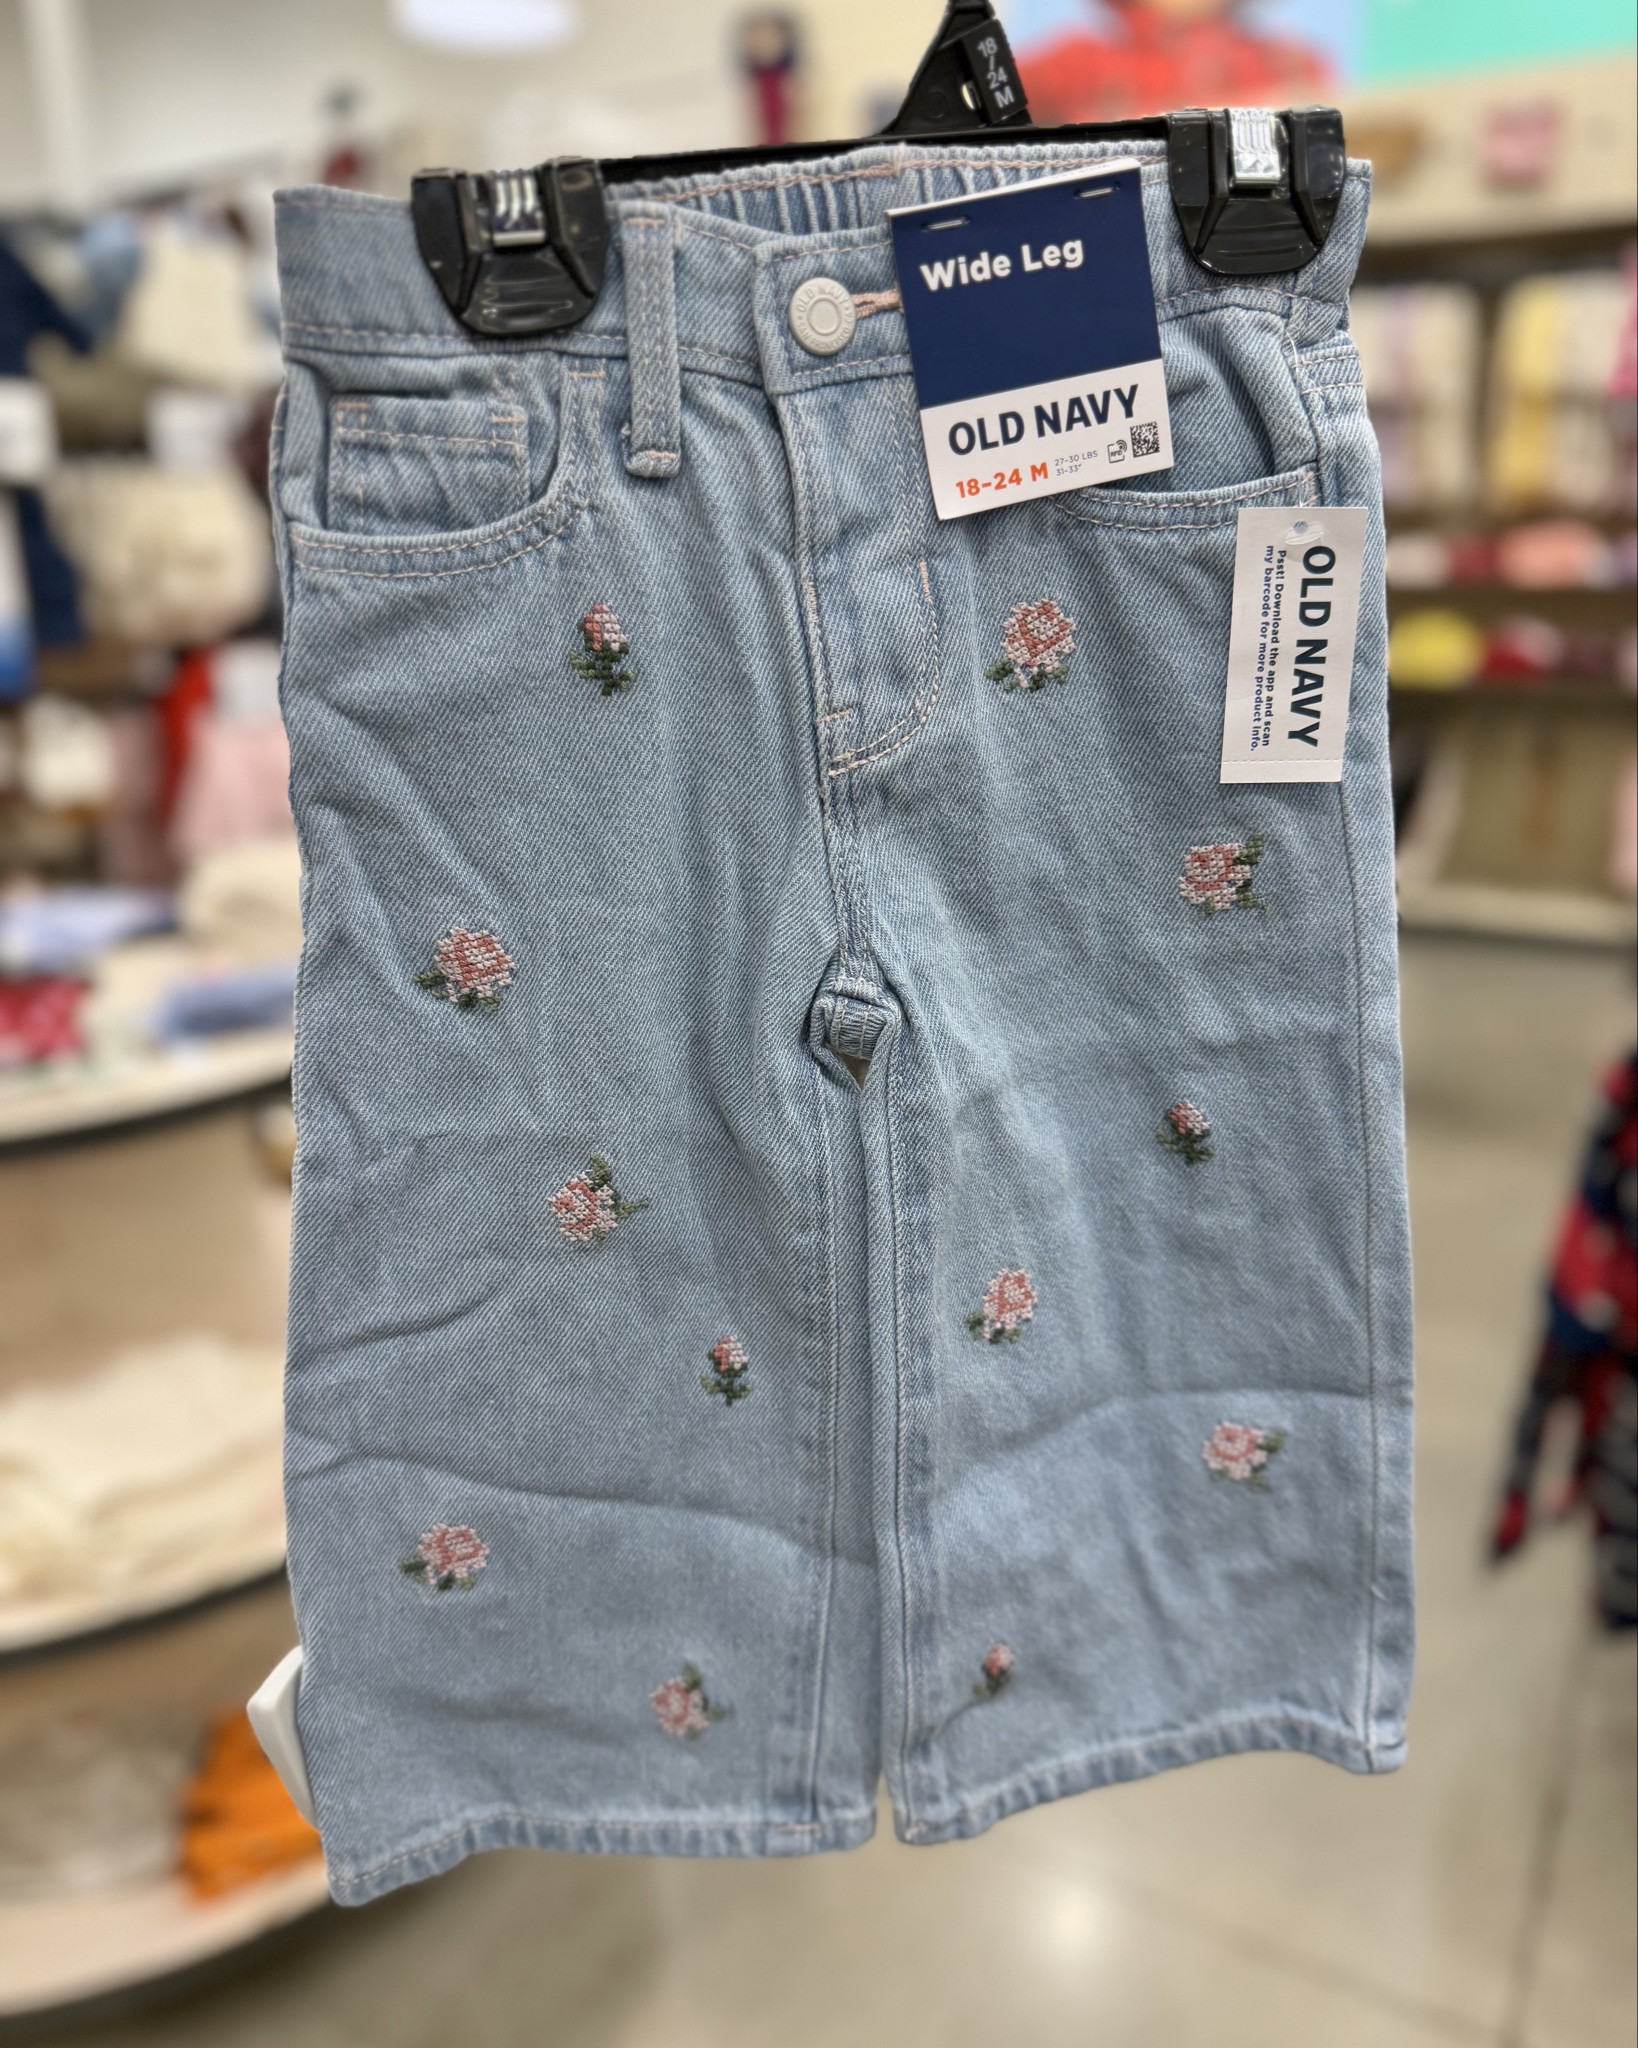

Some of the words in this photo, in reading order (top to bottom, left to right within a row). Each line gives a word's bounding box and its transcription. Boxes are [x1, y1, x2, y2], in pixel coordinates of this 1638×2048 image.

[977, 37, 998, 57] 18
[987, 66, 1008, 90] 24
[994, 86, 1015, 108] M
[919, 252, 1012, 292] Wide
[1021, 240, 1085, 273] Leg
[796, 289, 815, 312] OLD
[948, 410, 1025, 456] OLD
[1034, 384, 1139, 438] NAVY
[1054, 454, 1080, 467] 27-30
[1081, 450, 1098, 461] LBS
[1110, 449, 1123, 458] RFID
[955, 467, 1023, 499] 18-24
[1030, 462, 1049, 482] M
[1264, 545, 1274, 564] my
[1275, 550, 1287, 580] Psst!
[1261, 568, 1274, 618] barcode
[1299, 545, 1336, 627] OLD
[1270, 583, 1284, 644] Download
[1259, 621, 1270, 639] for
[1256, 642, 1266, 673] more
[1269, 647, 1279, 666] the
[1265, 670, 1275, 692] app
[1287, 638, 1329, 748] NAVY
[1253, 676, 1264, 723] product
[1264, 695, 1274, 717] and
[1250, 726, 1262, 752] info.
[1262, 721, 1271, 747] scan
